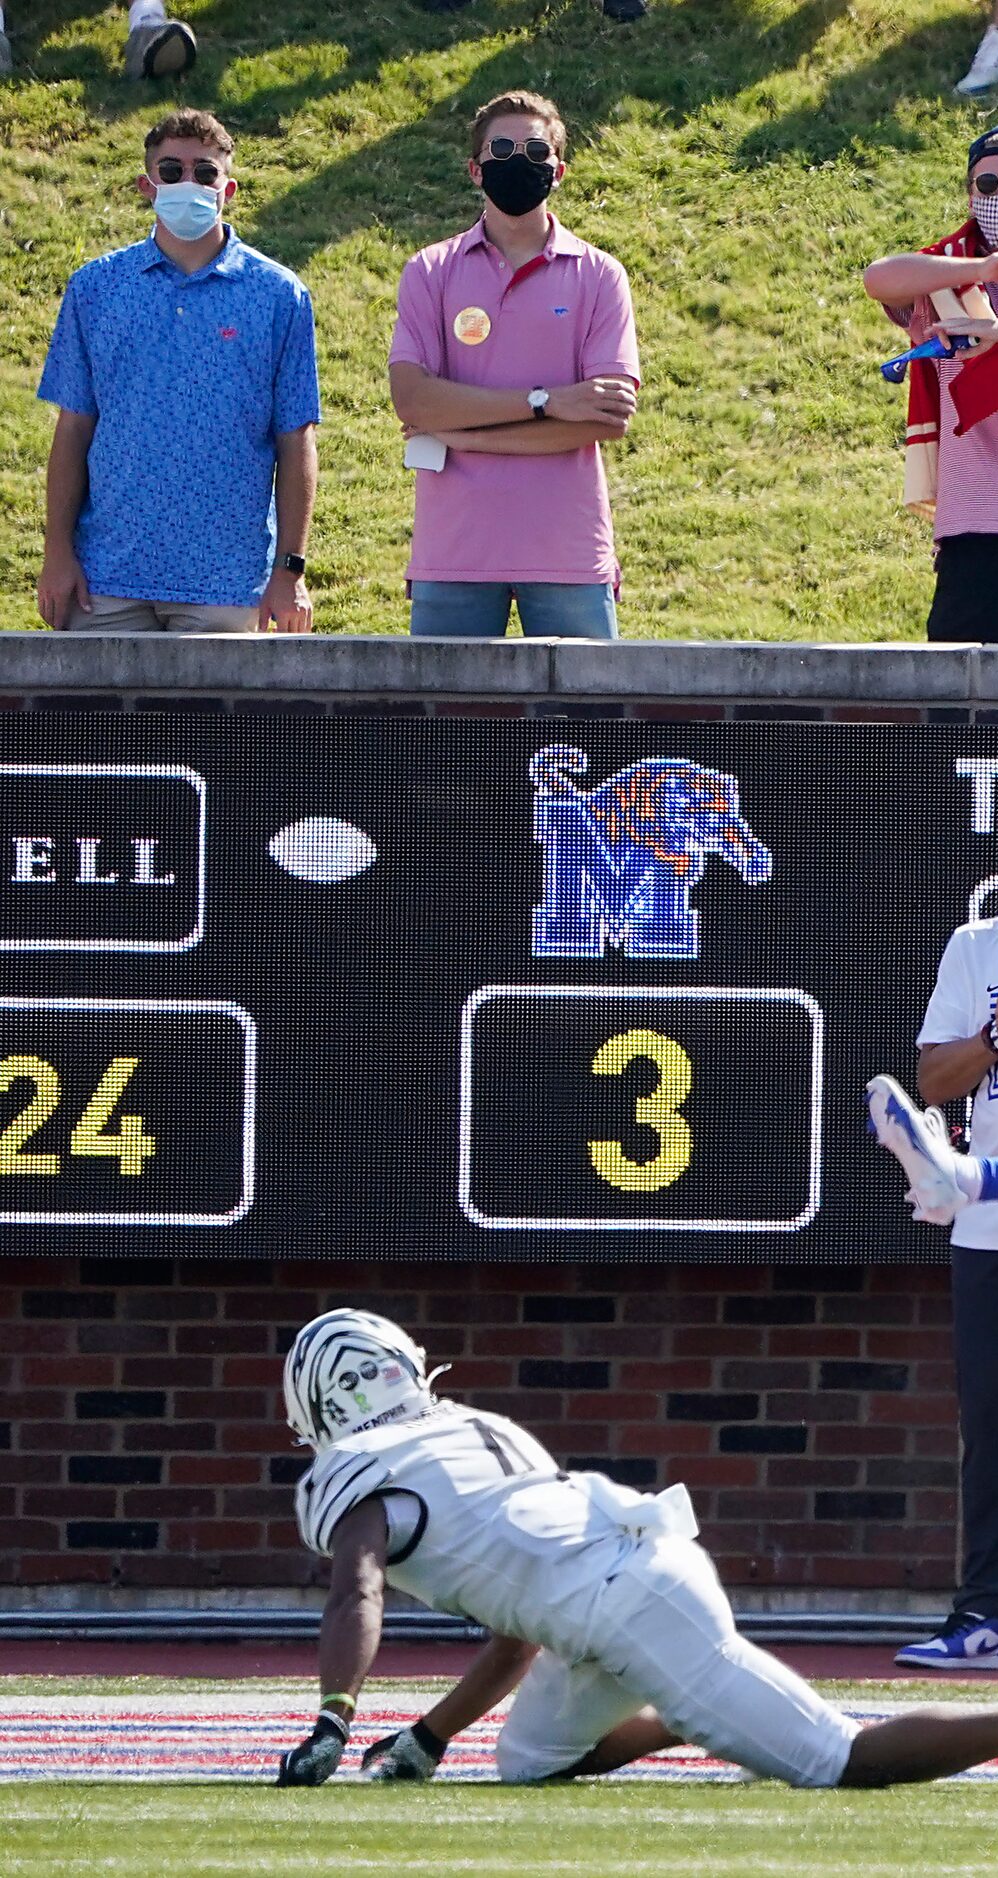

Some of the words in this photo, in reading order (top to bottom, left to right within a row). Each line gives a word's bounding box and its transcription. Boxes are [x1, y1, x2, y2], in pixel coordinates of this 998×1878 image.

[10, 836, 176, 884] ELL
[0, 1055, 157, 1176] 24
[586, 1028, 694, 1192] 3
